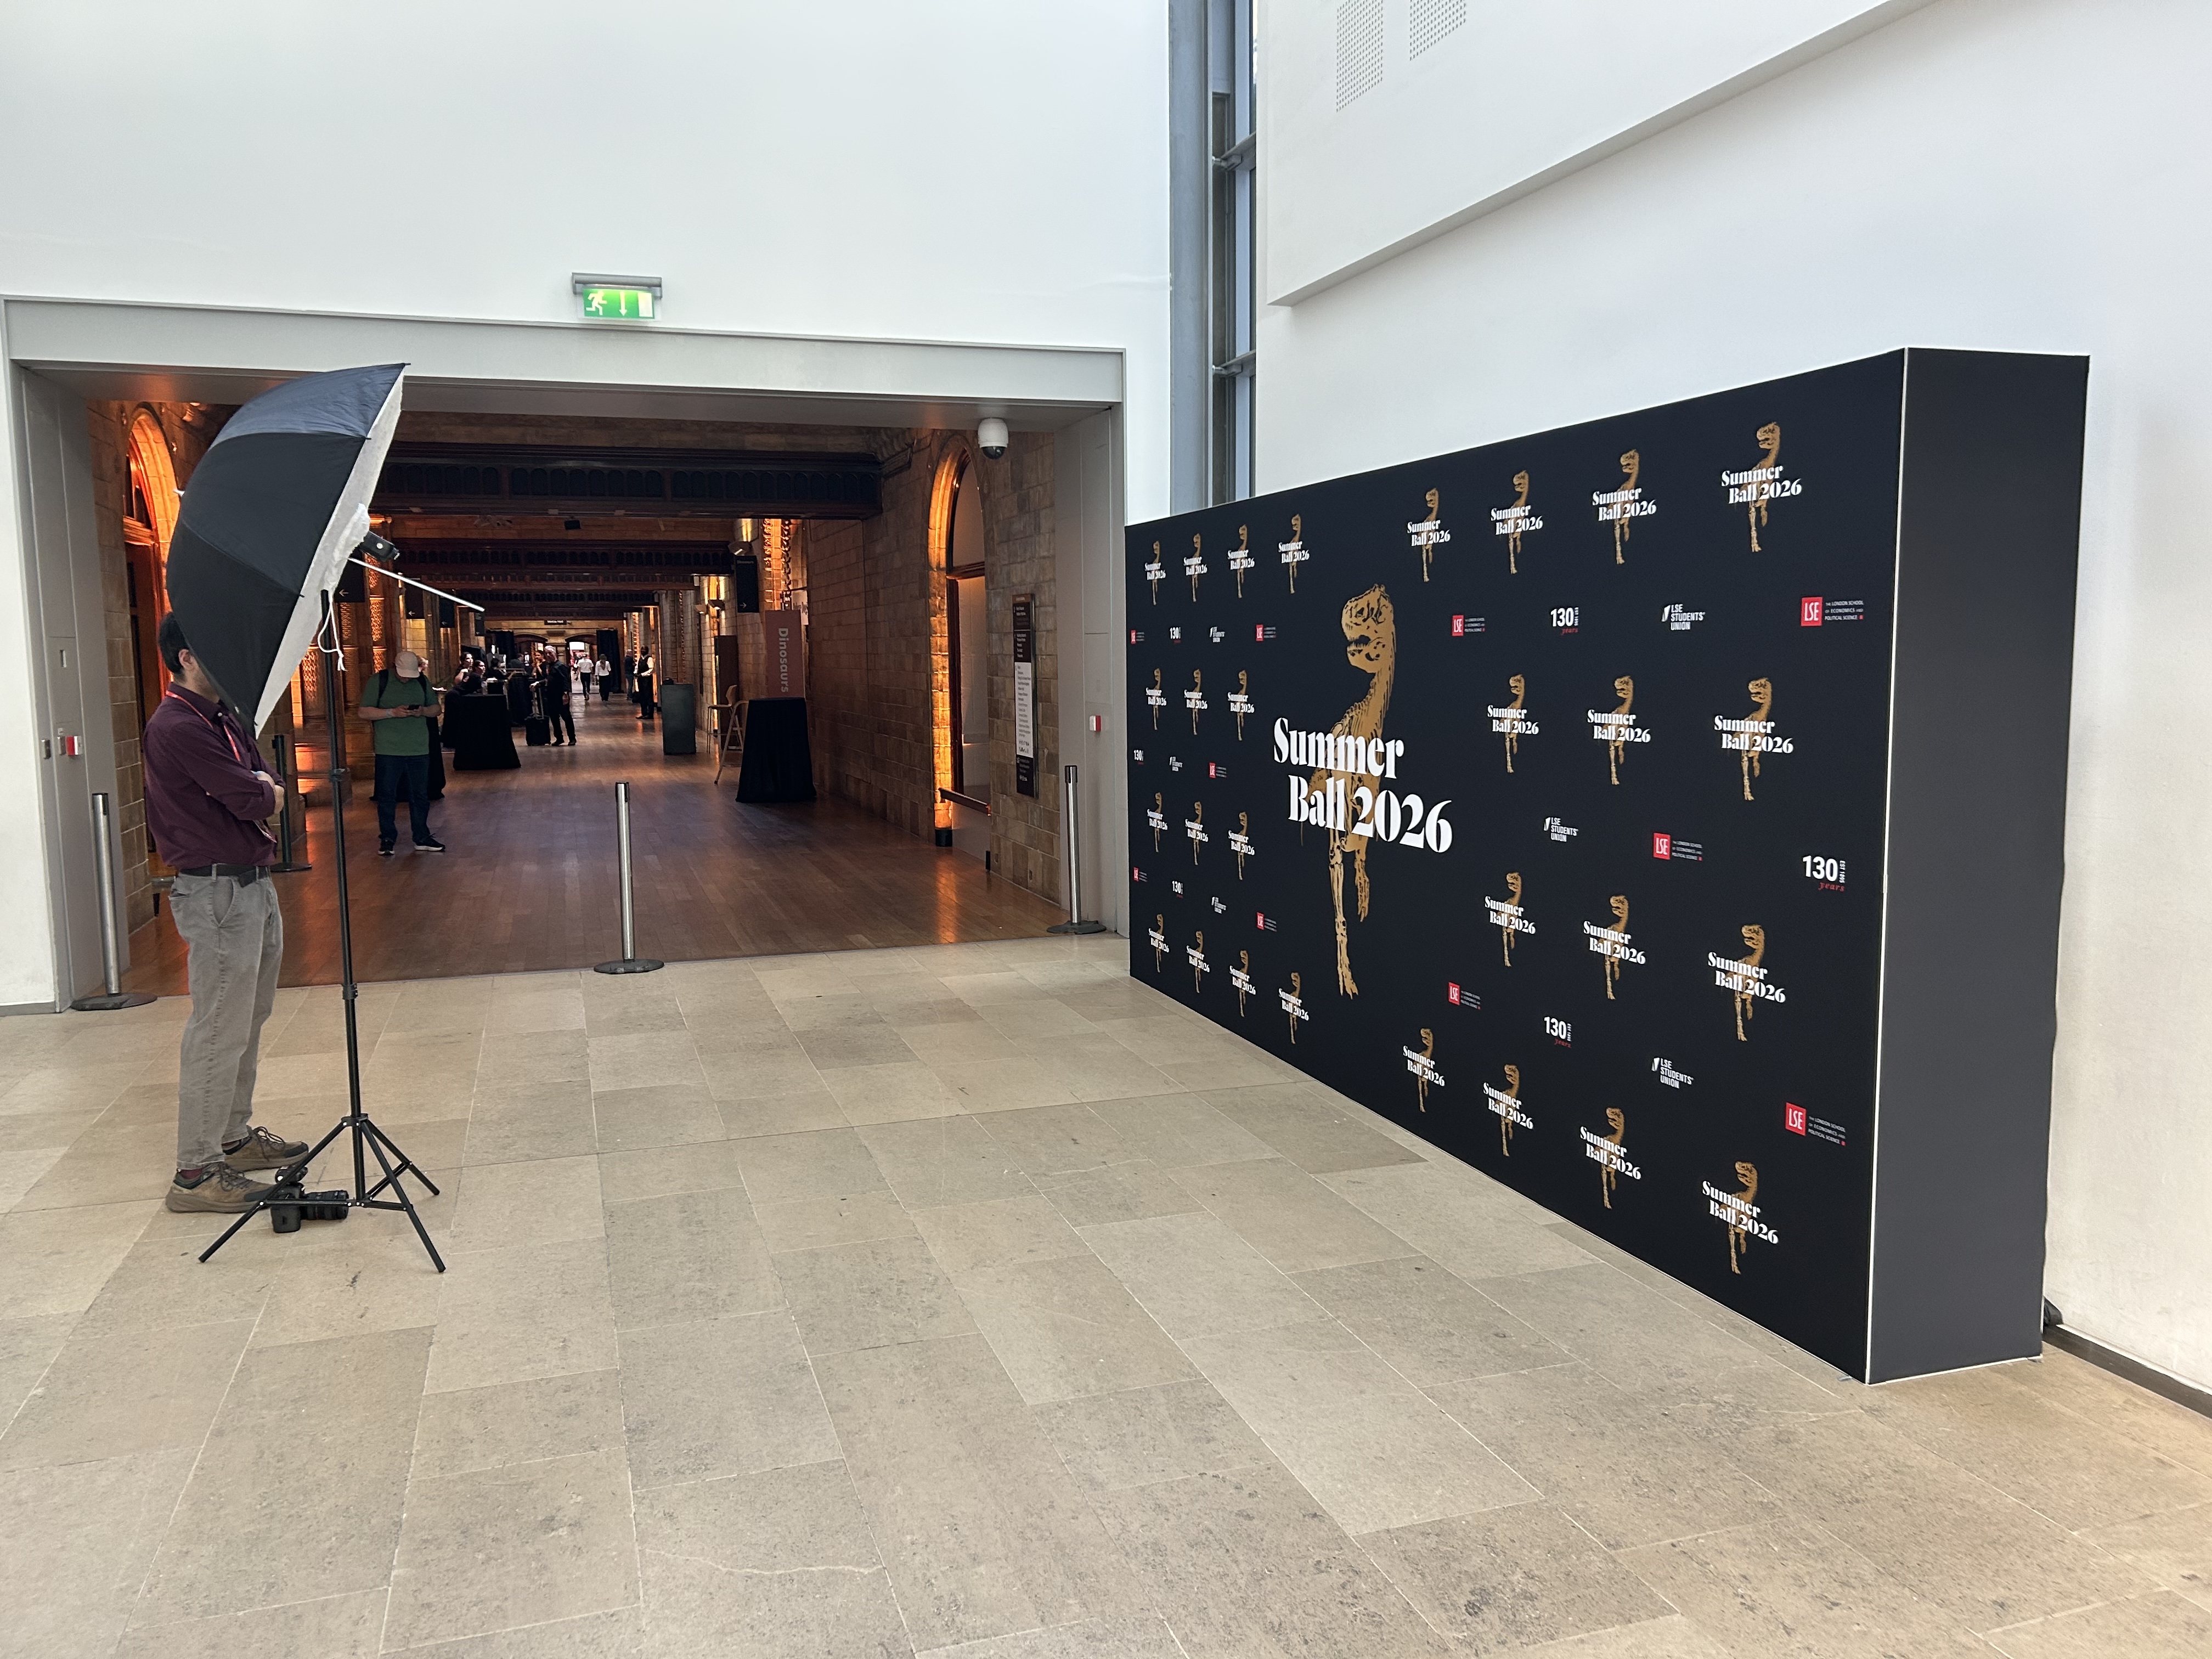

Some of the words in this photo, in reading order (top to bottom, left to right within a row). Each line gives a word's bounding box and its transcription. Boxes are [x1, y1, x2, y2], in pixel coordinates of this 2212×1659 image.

[1722, 464, 1783, 486] Summer
[1593, 487, 1641, 505] Summer
[1729, 483, 1759, 504] Ball
[1758, 479, 1802, 502] 2026
[1491, 505, 1531, 521] Summer
[1599, 503, 1622, 521] Ball
[1622, 500, 1656, 520] 2026
[1408, 520, 1440, 533] Summer
[1496, 518, 1515, 535] Ball
[1515, 516, 1543, 534] 2026
[1279, 541, 1302, 552] Summer
[1412, 532, 1427, 546] Ball
[1427, 530, 1450, 545] 2026
[1240, 558, 1254, 570] 2026
[1282, 551, 1293, 563] Ball
[1293, 550, 1309, 563] 2026
[1154, 570, 1166, 579] 2026
[1195, 565, 1207, 575] 2026
[1672, 604, 1683, 612] LSE
[1805, 602, 1819, 621] LSE
[1454, 619, 1462, 632] LSE
[1551, 608, 1574, 627] 130
[1170, 627, 1178, 639] 130
[778, 628, 789, 693] Dinosaurs
[1156, 697, 1166, 706] 2026
[1195, 700, 1207, 709] 2026
[1240, 703, 1254, 713] 2026
[1488, 705, 1527, 719] Summer
[1588, 710, 1636, 726] Summer
[1493, 719, 1511, 735] Ball
[1511, 720, 1538, 735] 2026
[1714, 715, 1775, 733] Summer
[1594, 725, 1617, 742] Ball
[1616, 726, 1651, 743] 2026
[1722, 733, 1751, 752] Ball
[1751, 734, 1793, 753] 2026
[1274, 718, 1404, 778] Summer
[1289, 775, 1345, 831] Ball
[1350, 787, 1452, 853] 2026
[1157, 821, 1167, 830] 2026
[1195, 831, 1208, 842] 2026
[1241, 844, 1255, 855] 2026
[1656, 838, 1668, 855] LSE
[1803, 856, 1838, 881] 130
[1172, 881, 1181, 893] 130
[1819, 883, 1844, 891] years
[1485, 896, 1523, 916] Summer
[1490, 911, 1509, 927] Ball
[1508, 915, 1535, 934] 2026
[1584, 921, 1631, 944] Summer
[1159, 941, 1169, 952] 2026
[1590, 938, 1612, 956] Ball
[1612, 942, 1645, 964] 2026
[1198, 960, 1210, 972] 2026
[1708, 952, 1768, 979] Summer
[1242, 981, 1256, 995] 2026
[1450, 986, 1458, 1001] LSE
[1716, 970, 1744, 993] Ball
[1743, 977, 1786, 1002] 2026
[1279, 989, 1302, 1006] Summer
[1282, 1000, 1293, 1013] Ball
[1293, 1006, 1308, 1020] 2026
[1544, 1017, 1566, 1039] 130
[1403, 1046, 1435, 1069] Summer
[1661, 1058, 1672, 1069] LSE
[1408, 1059, 1422, 1076] Ball
[1423, 1068, 1444, 1086] 2026
[1483, 1082, 1521, 1109] Summer
[1488, 1098, 1506, 1116] Ball
[1507, 1108, 1533, 1129] 2026
[1789, 1108, 1803, 1130] LSE
[1581, 1127, 1627, 1157] Summer
[1587, 1143, 1609, 1165] Ball
[1609, 1155, 1641, 1180] 2026
[1703, 1181, 1760, 1217] Summer
[1710, 1200, 1737, 1226] Ball
[1737, 1215, 1778, 1244] 2026
